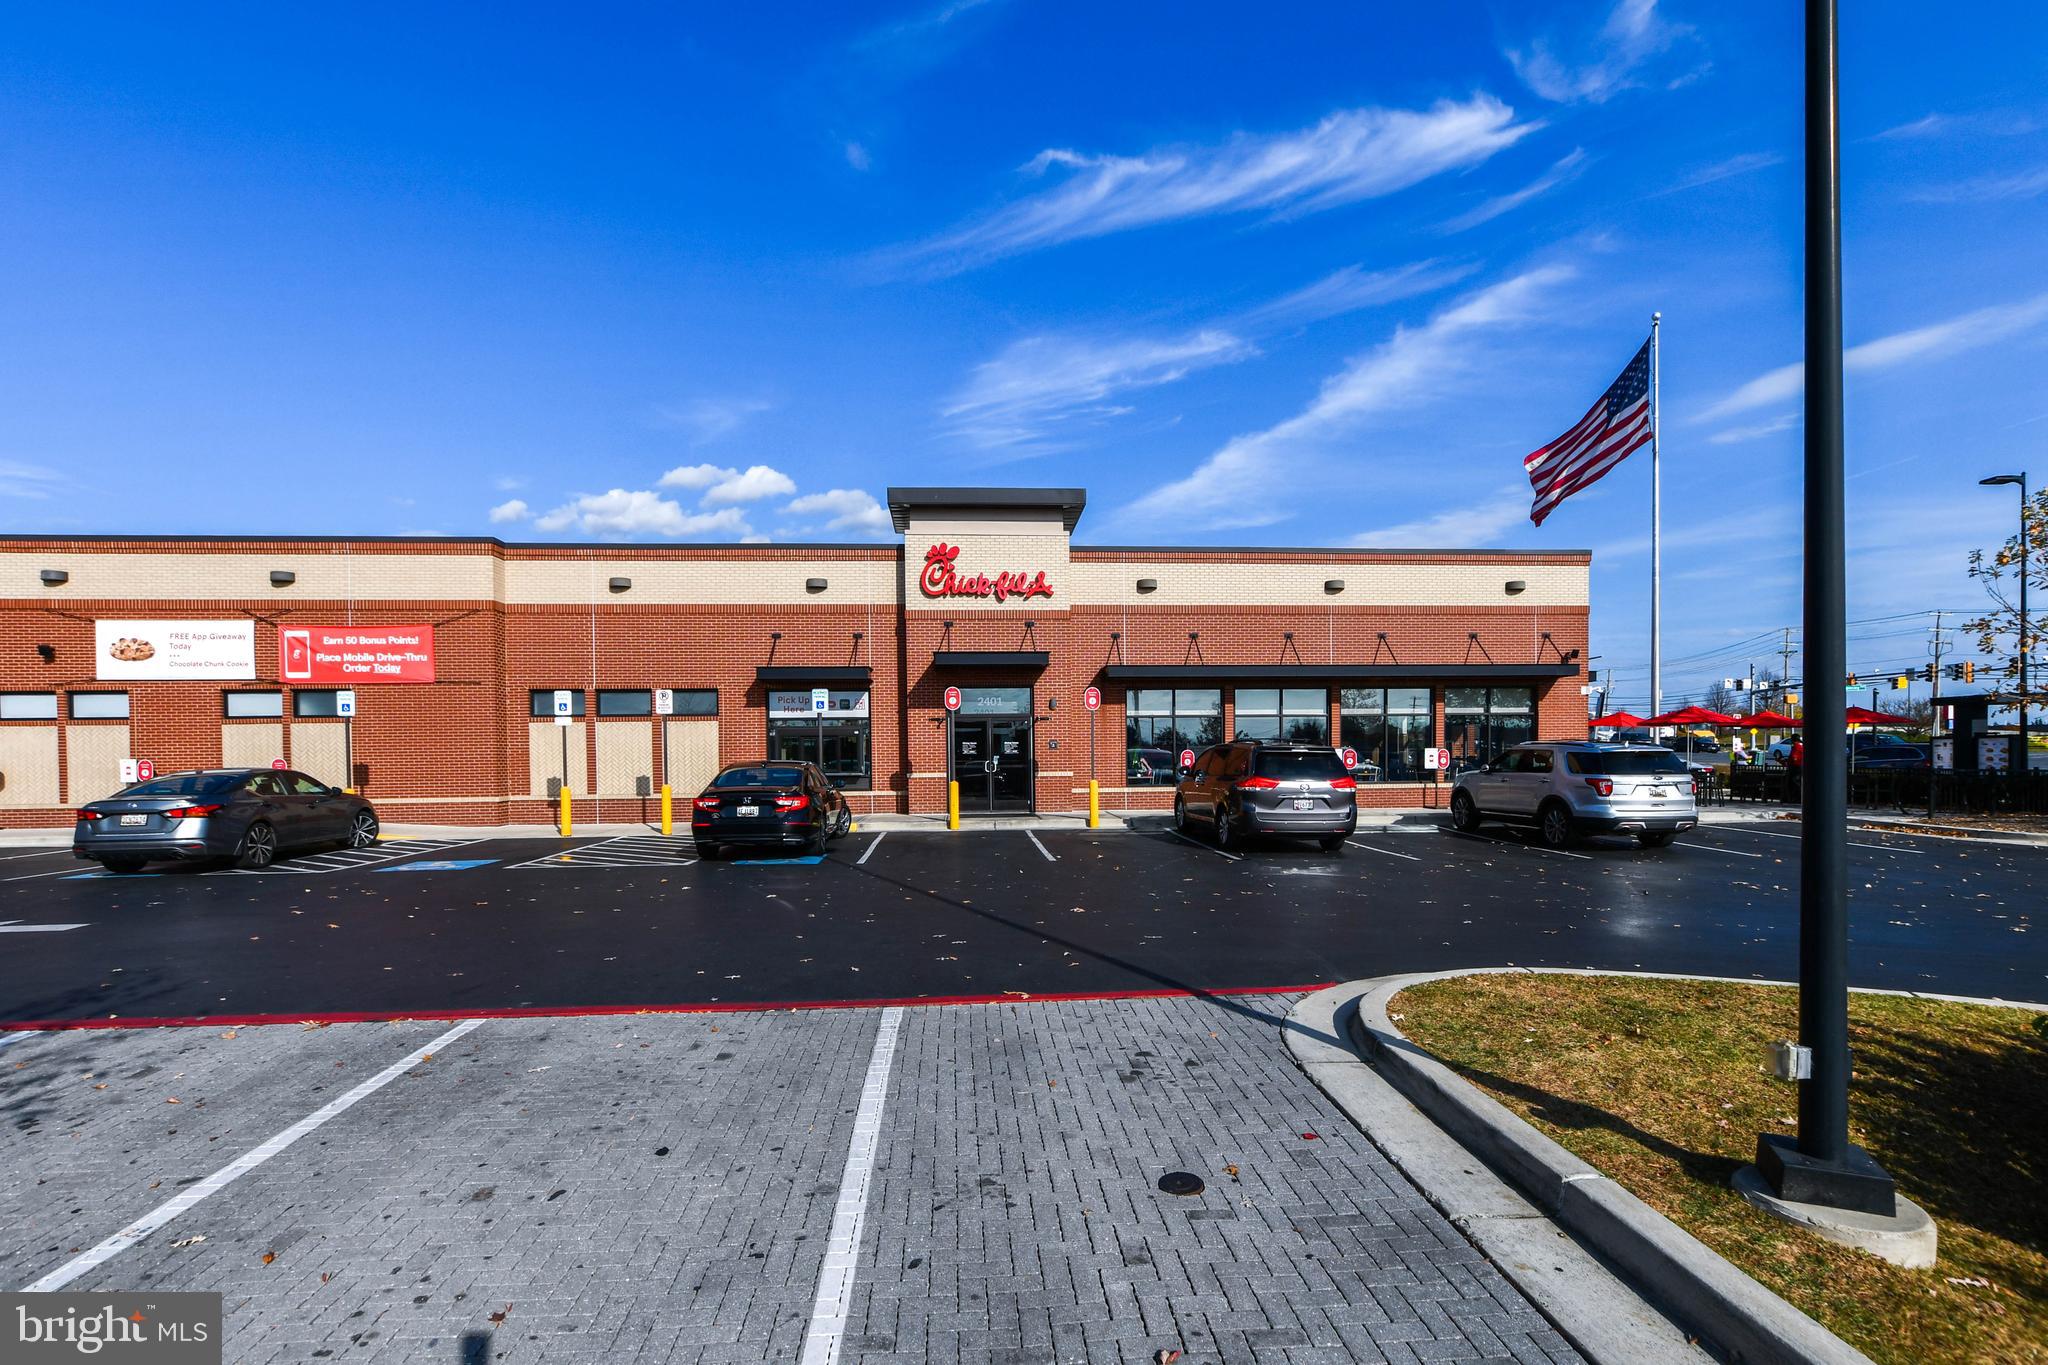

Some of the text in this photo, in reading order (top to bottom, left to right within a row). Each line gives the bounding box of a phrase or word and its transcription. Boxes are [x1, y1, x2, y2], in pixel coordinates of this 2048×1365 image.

[920, 543, 1054, 600] Chick-fil-A
[191, 633, 207, 641] App
[210, 633, 247, 641] Giveaway
[323, 636, 419, 645] Earn 50 Bonus Points!
[169, 643, 192, 651] Today
[316, 653, 427, 662] Place Mobile Drive-Thru
[343, 664, 401, 674] Order Today
[777, 696, 810, 705] Pick Up
[977, 696, 1003, 706] 2401
